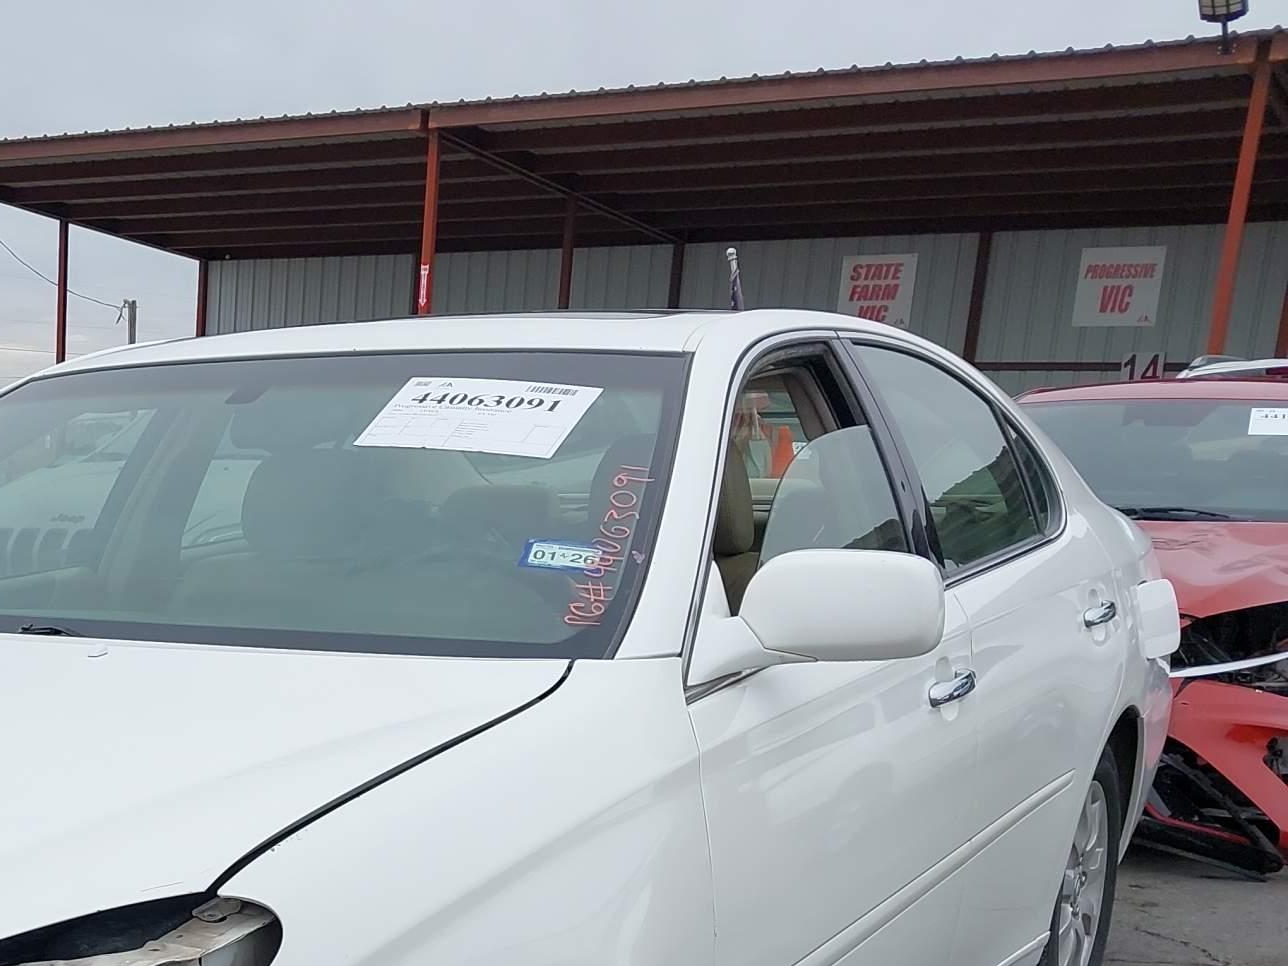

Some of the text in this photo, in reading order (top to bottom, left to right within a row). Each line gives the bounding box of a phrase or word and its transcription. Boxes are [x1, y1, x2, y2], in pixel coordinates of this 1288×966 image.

[850, 263, 904, 281] STATE
[1084, 263, 1157, 280] PROGRESSIVE
[848, 284, 900, 302] FARM
[1099, 285, 1133, 313] VIC
[856, 304, 889, 322] VIC
[1123, 353, 1161, 381] 14
[411, 391, 562, 413] 44063091
[533, 549, 557, 561] 01
